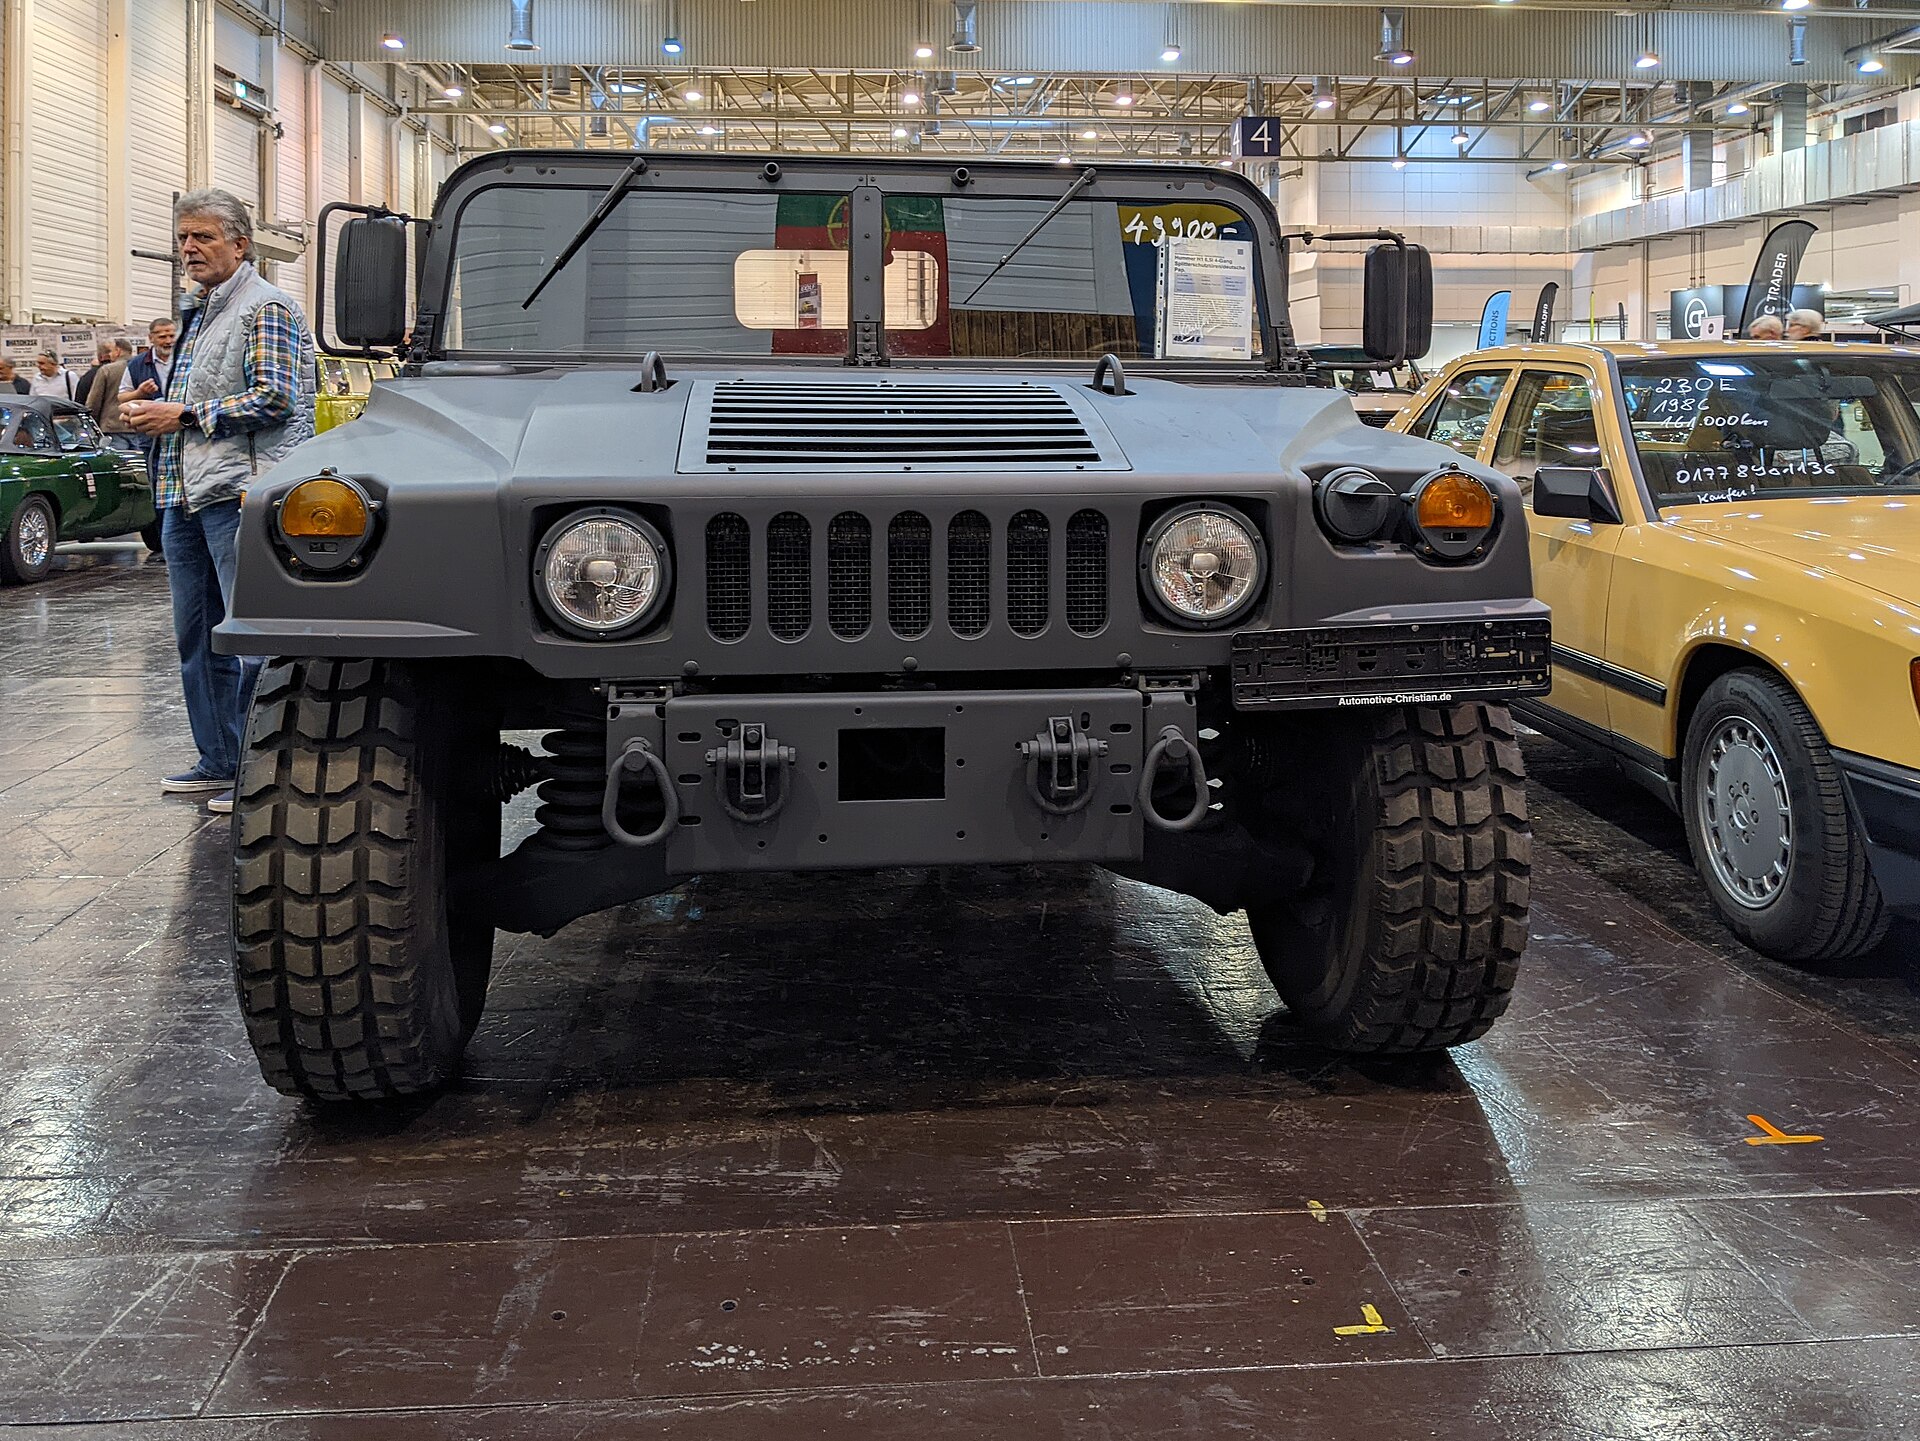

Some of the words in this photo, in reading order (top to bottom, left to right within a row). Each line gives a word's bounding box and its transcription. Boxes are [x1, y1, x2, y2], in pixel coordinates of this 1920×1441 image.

[1232, 123, 1240, 155] 4
[1250, 120, 1272, 153] 4
[1767, 252, 1788, 302] TRADER
[1655, 377, 1714, 393] 230
[1720, 378, 1737, 391] E
[1653, 398, 1710, 413] 1986
[1676, 465, 1730, 484] 0177
[1338, 692, 1452, 706] Automotive-Christian.de
